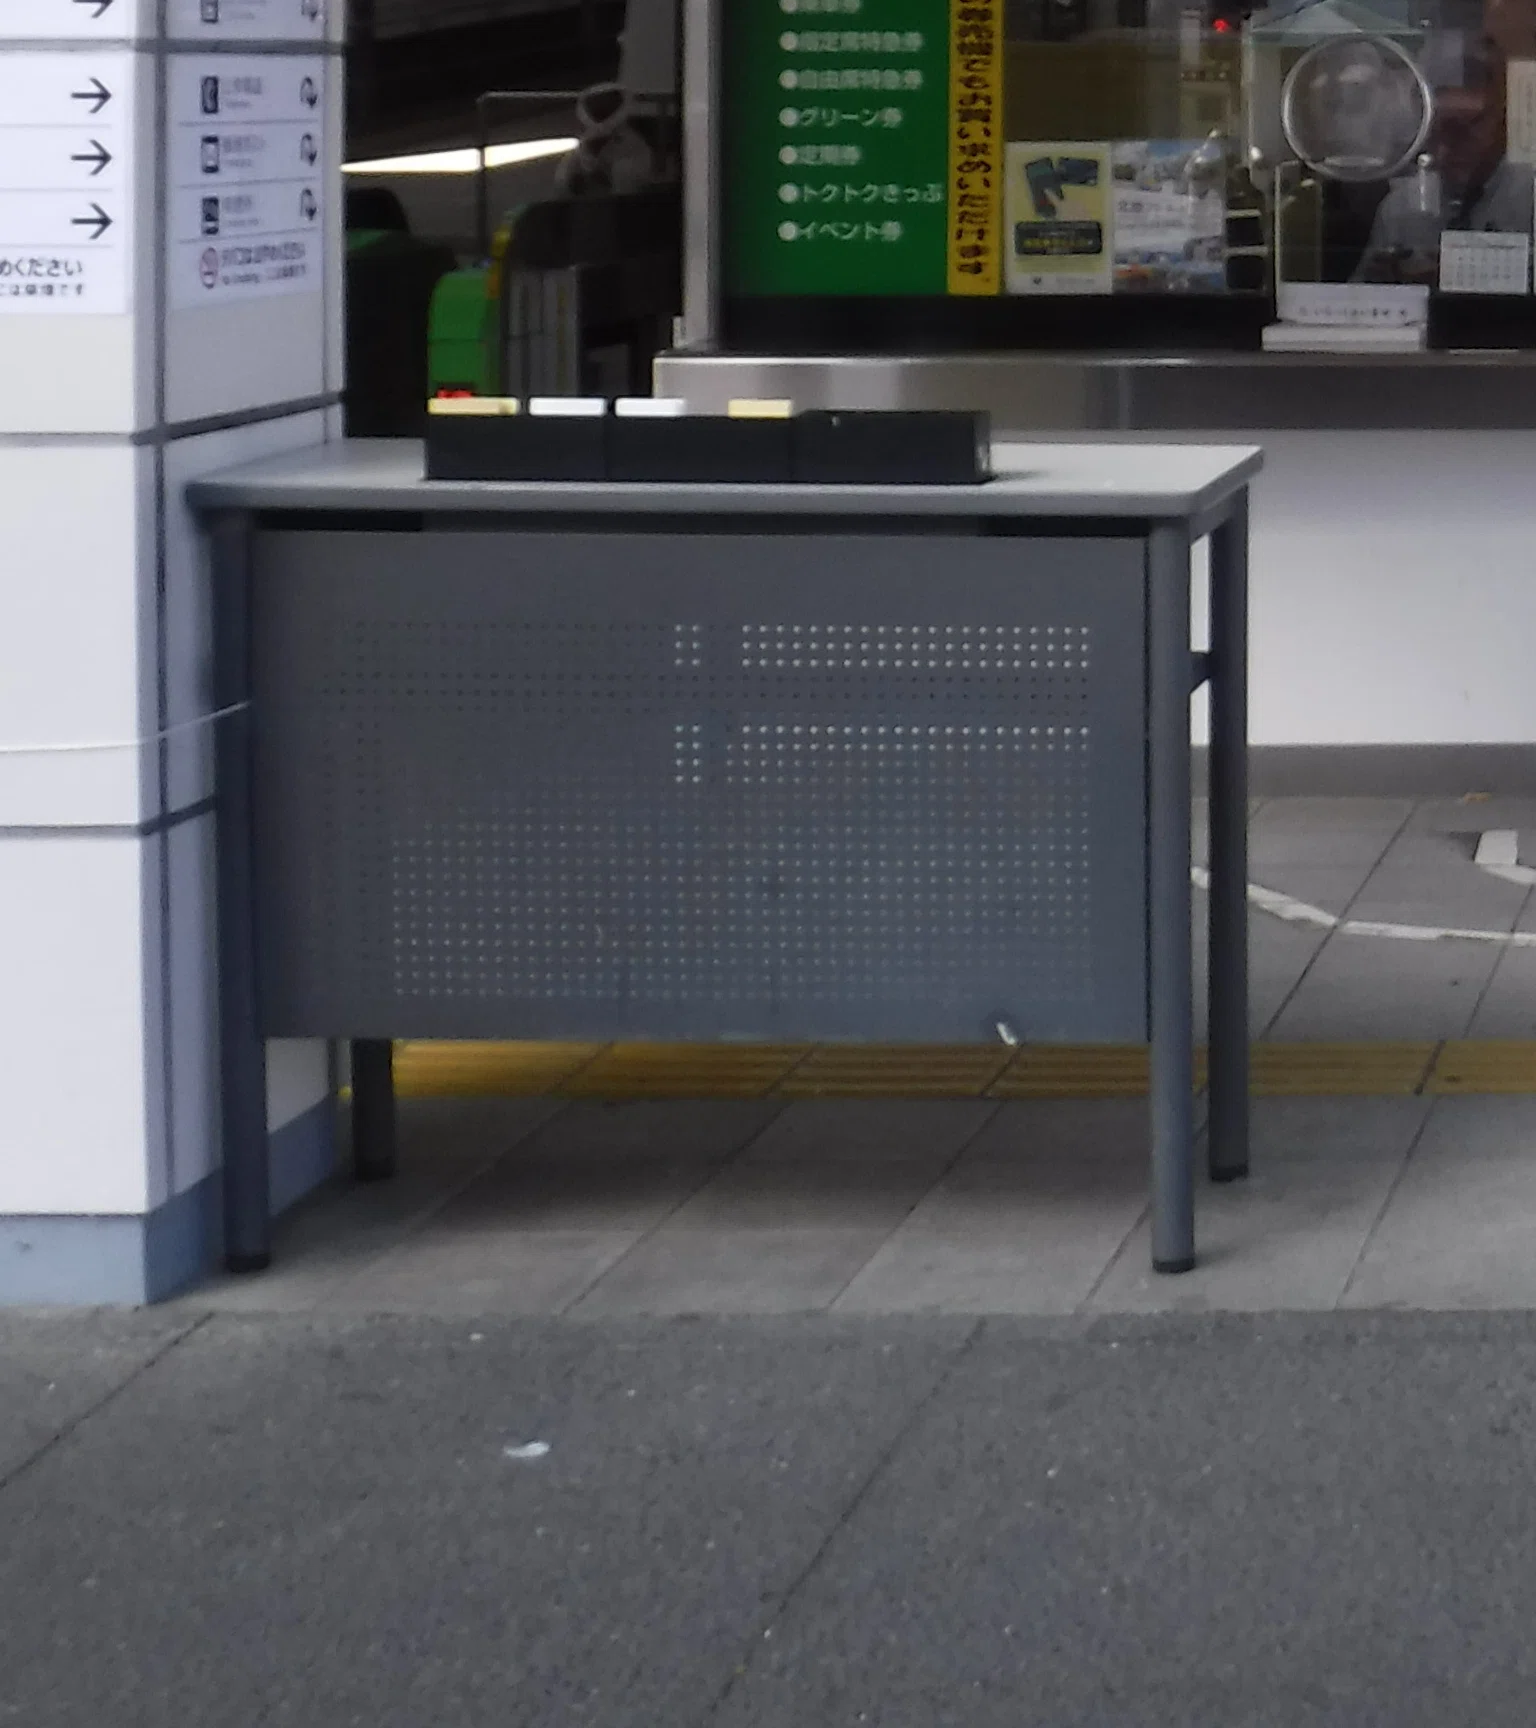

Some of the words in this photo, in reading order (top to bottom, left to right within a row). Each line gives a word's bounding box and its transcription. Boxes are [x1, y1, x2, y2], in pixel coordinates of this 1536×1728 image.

[803, 182, 944, 203] トクトクきっぷ
